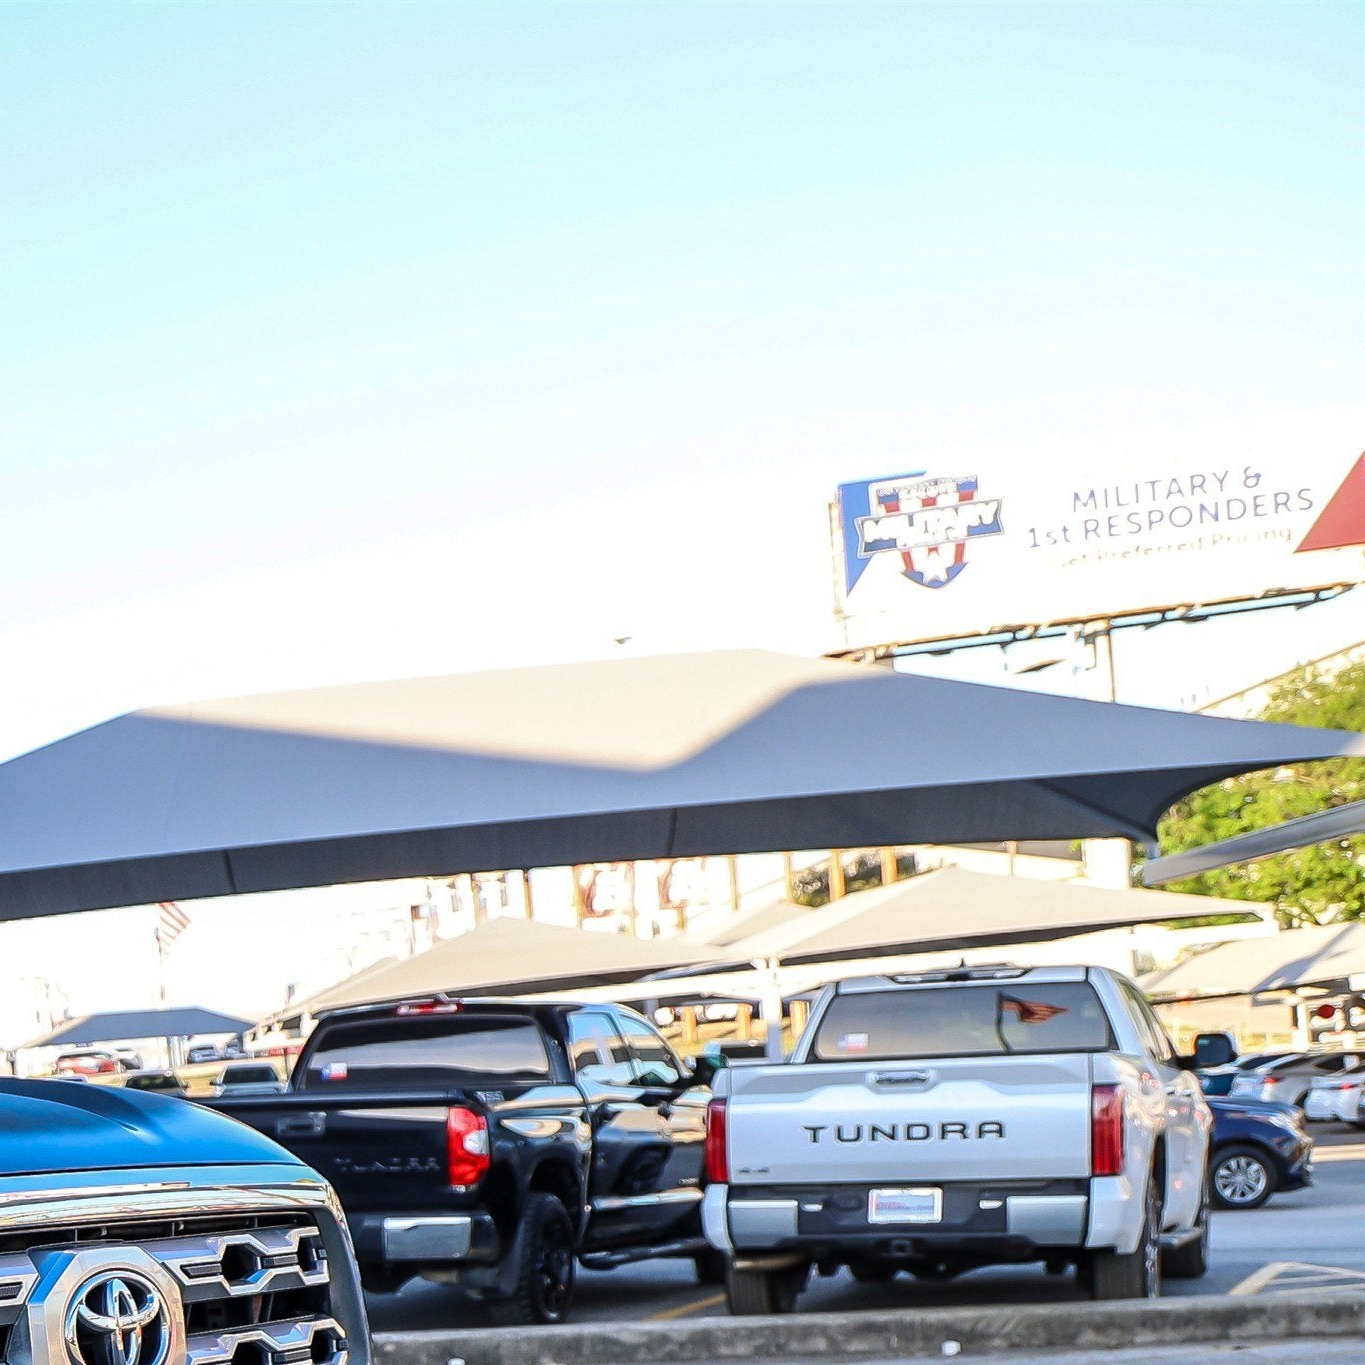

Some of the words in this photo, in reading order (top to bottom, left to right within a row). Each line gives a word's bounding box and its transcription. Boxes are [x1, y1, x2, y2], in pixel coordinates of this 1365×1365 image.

[1072, 469, 1229, 513] MILITARY
[1242, 466, 1262, 489] &
[1028, 525, 1070, 548] 1st
[1083, 487, 1314, 541] RESPONDERS
[801, 1120, 1007, 1144] TUNDRA
